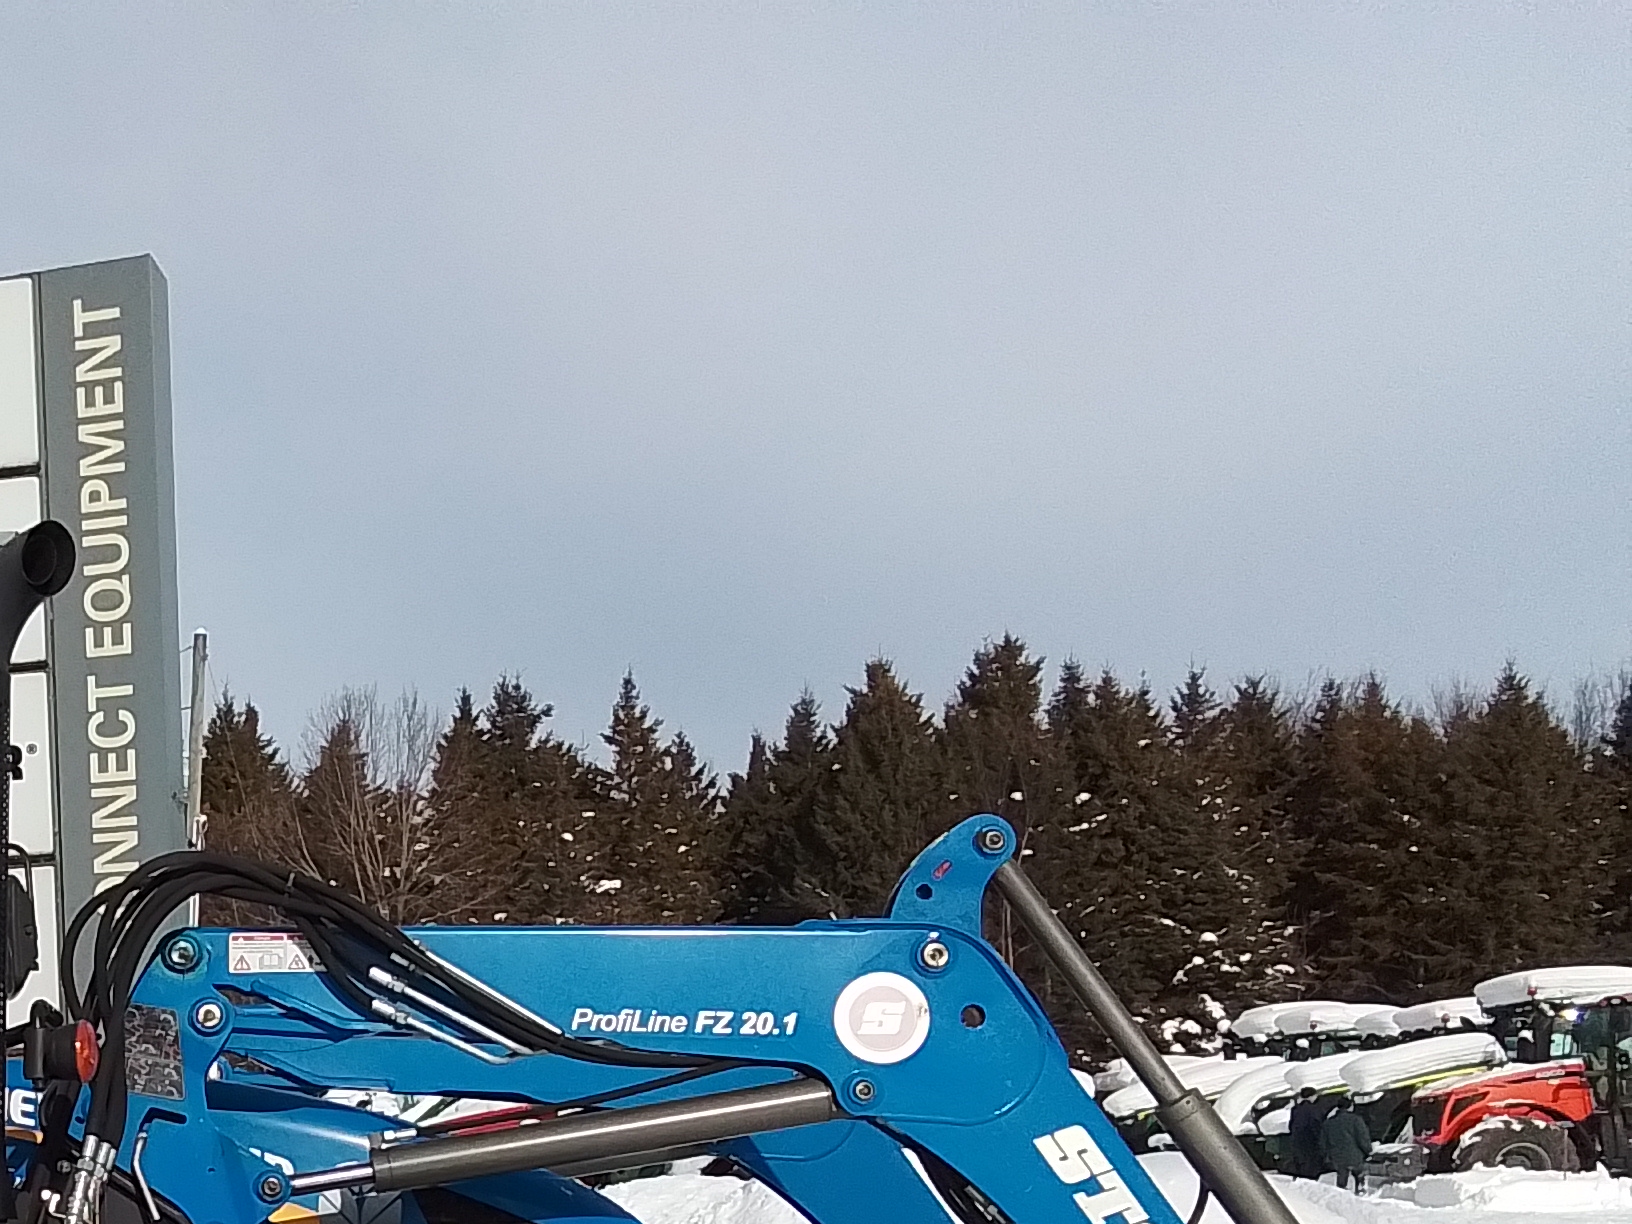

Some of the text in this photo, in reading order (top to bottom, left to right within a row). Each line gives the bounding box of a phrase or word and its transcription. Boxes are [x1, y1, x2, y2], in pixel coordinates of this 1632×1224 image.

[72, 298, 132, 659] EQUIPMENT
[570, 1008, 799, 1036] ProfiLine FZ 20.1
